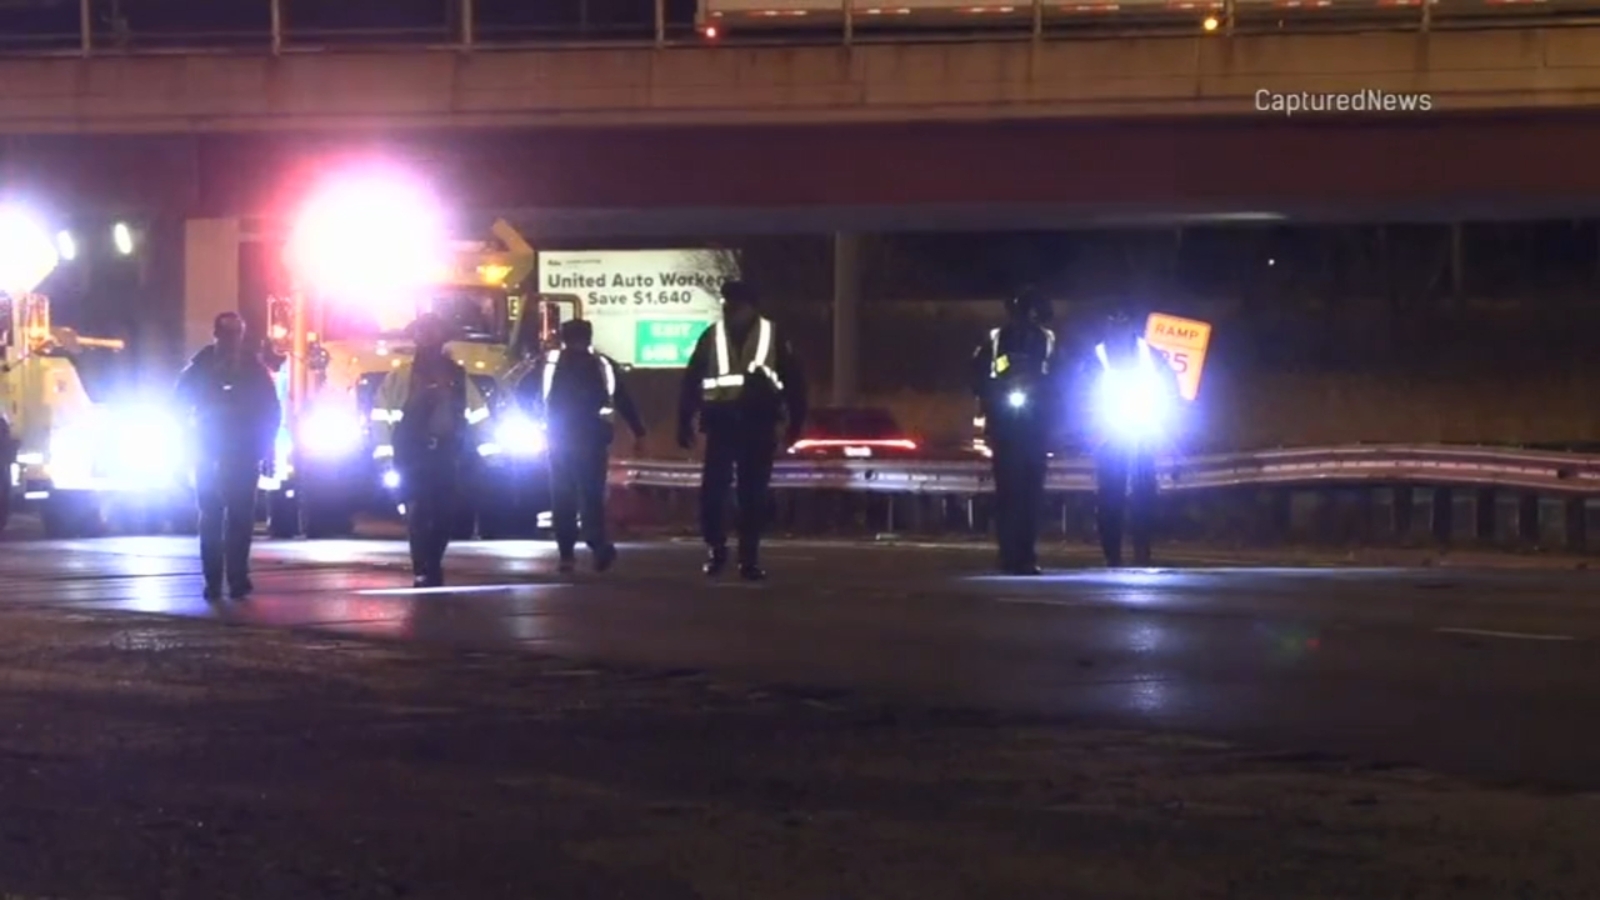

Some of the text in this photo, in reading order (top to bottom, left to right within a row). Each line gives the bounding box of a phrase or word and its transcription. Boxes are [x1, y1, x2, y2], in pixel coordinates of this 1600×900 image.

[547, 271, 730, 288] United Auto Worker
[588, 291, 628, 305] Save
[1155, 323, 1199, 340] RAMP
